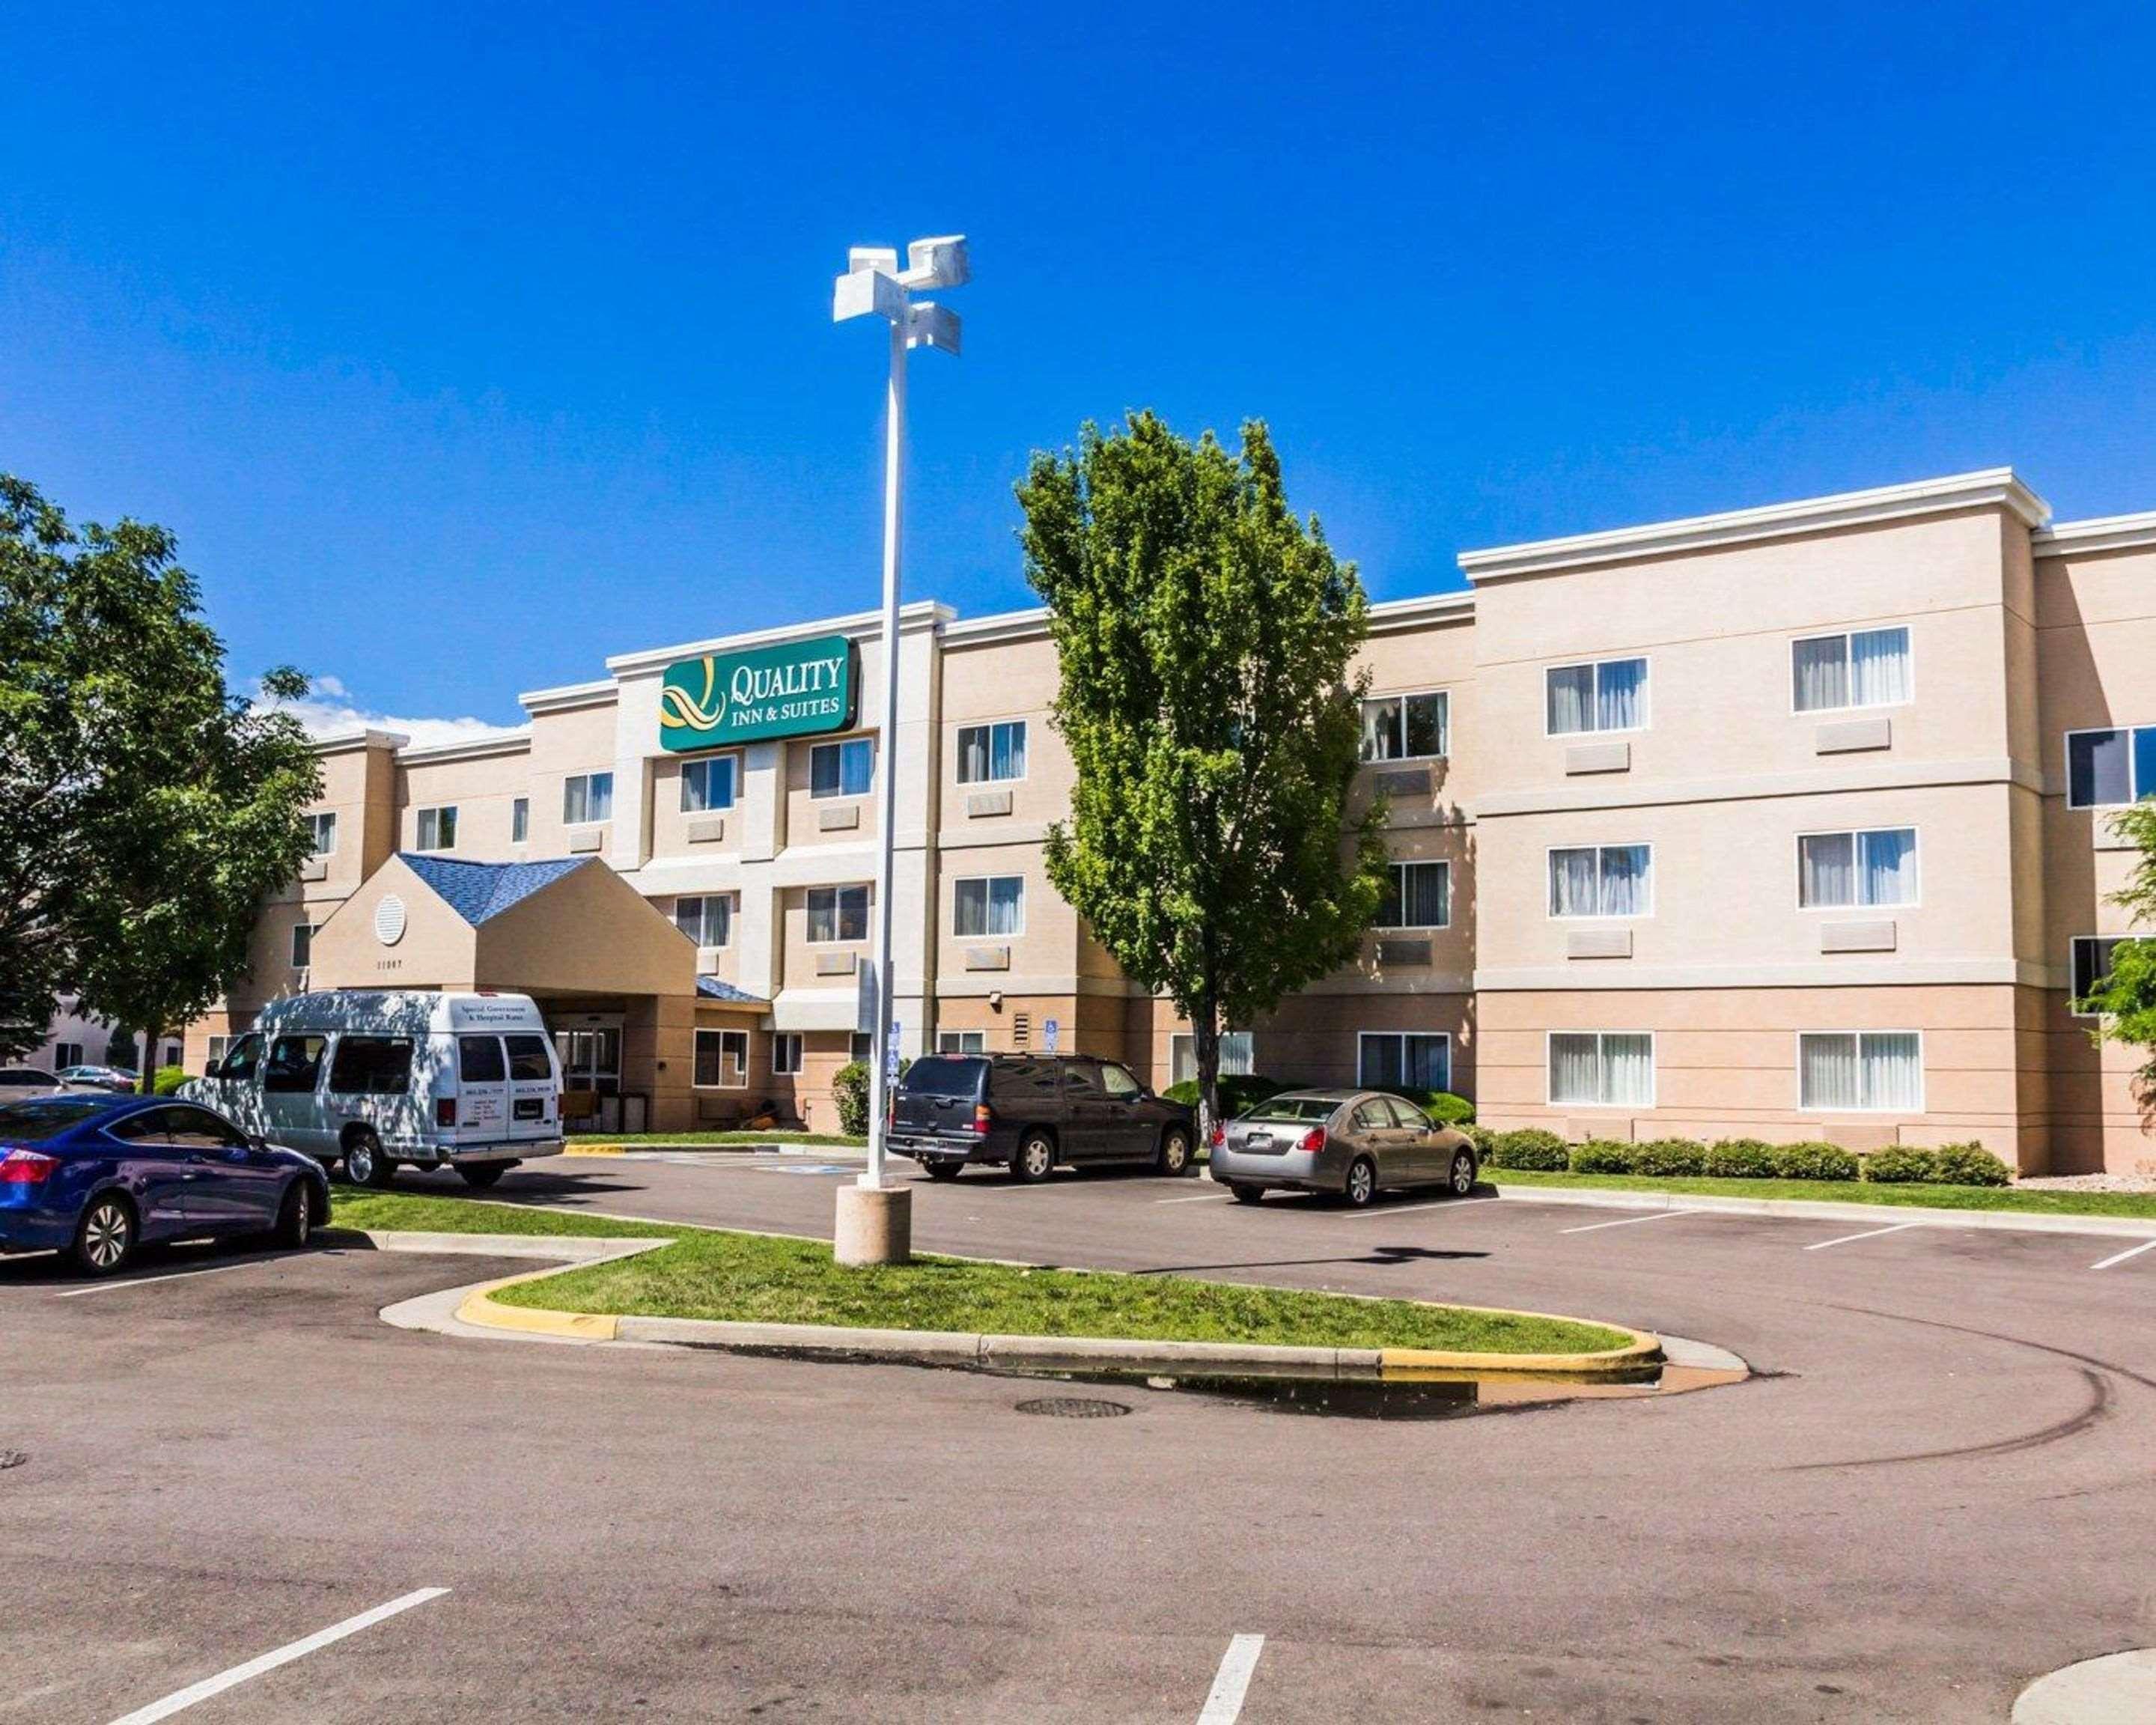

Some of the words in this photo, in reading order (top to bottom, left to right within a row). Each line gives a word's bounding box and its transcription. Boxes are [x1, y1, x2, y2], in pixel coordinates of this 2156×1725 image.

[731, 657, 844, 706] QUALITY
[731, 708, 764, 727] INN
[766, 706, 778, 722] &
[780, 697, 839, 720] SUITES
